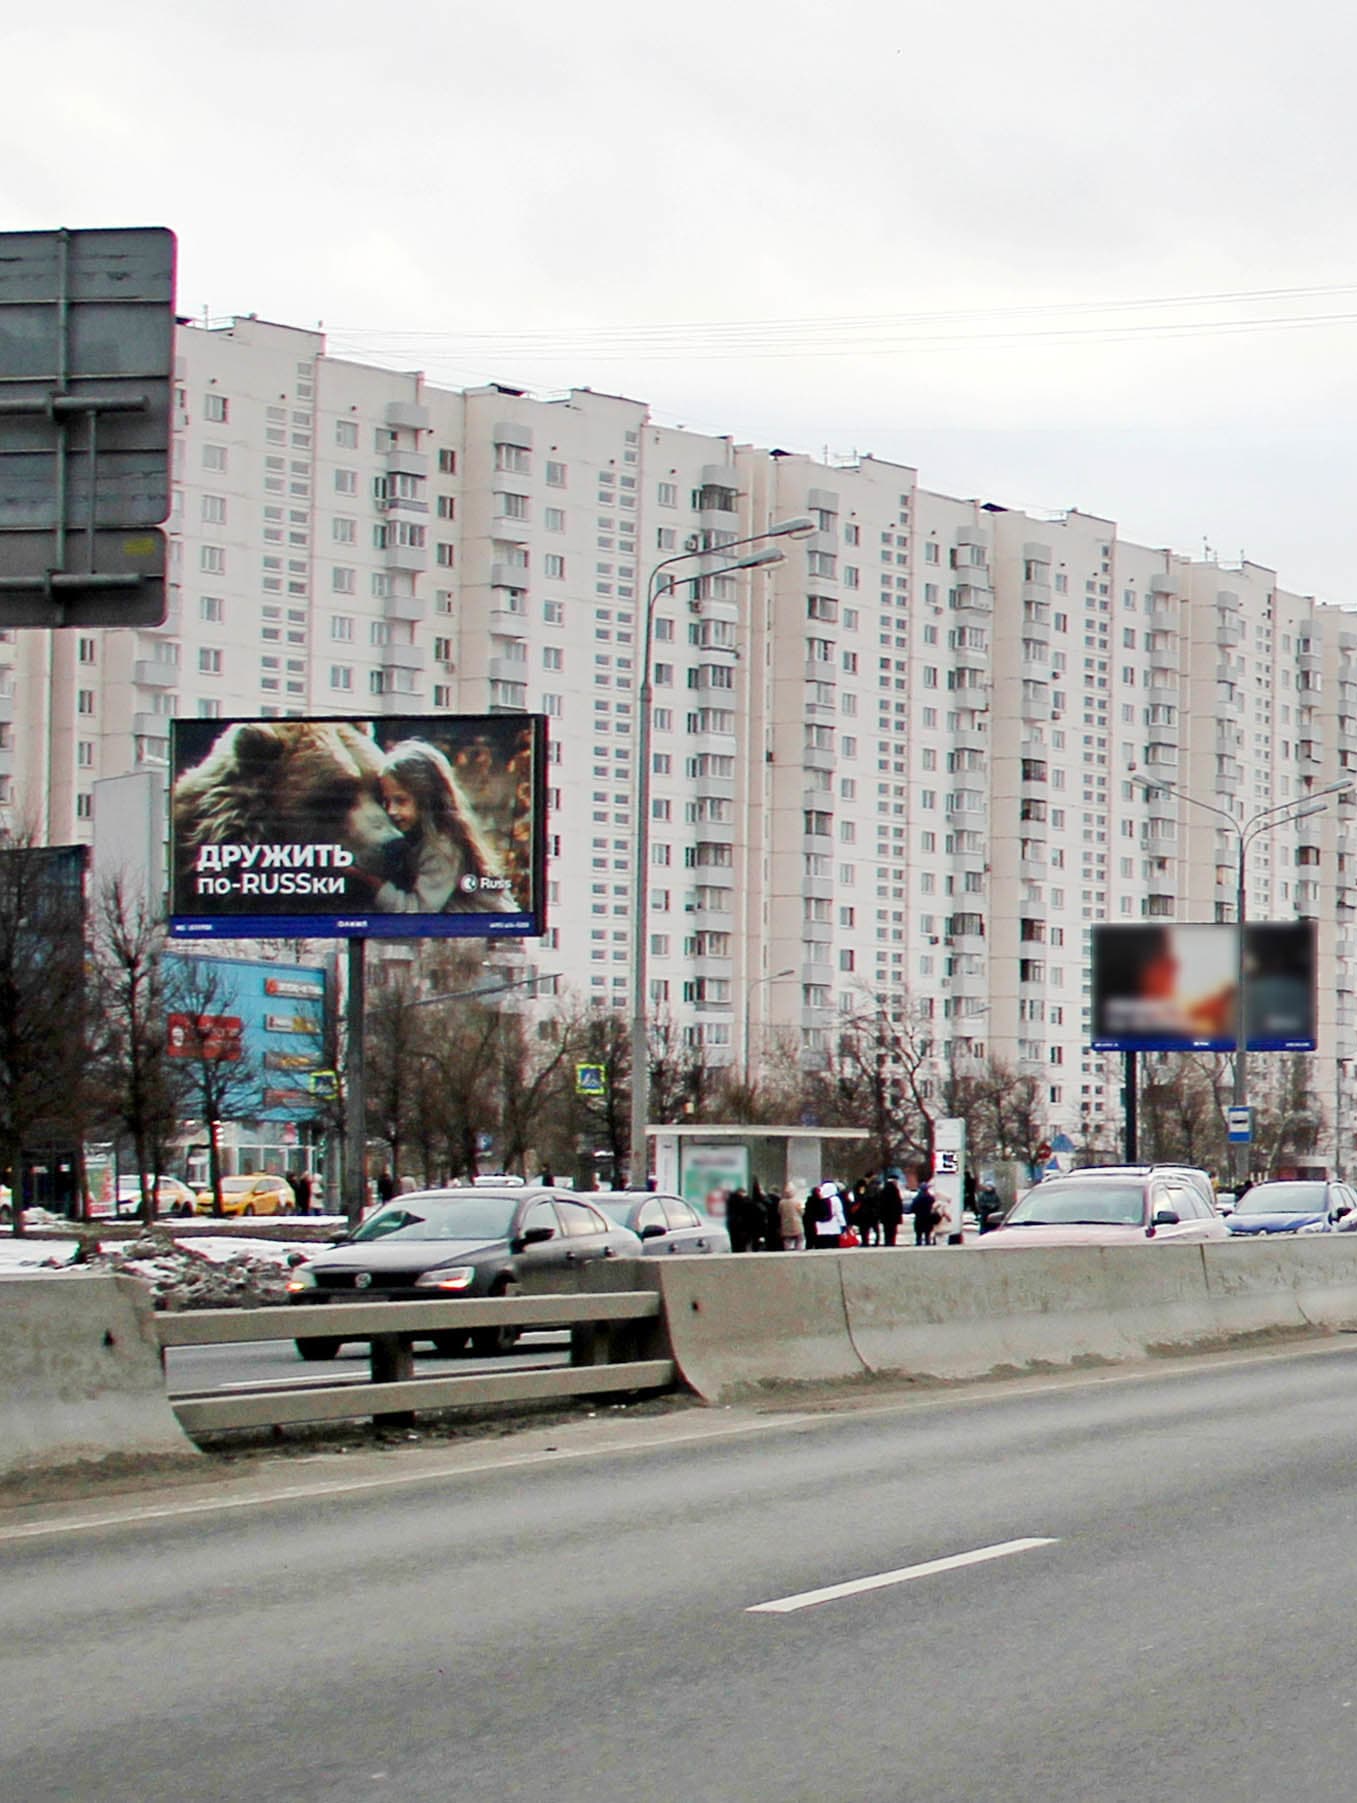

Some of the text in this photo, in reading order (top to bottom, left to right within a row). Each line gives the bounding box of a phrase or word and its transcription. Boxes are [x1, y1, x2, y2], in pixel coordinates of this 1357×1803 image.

[196, 844, 354, 872] ДРУЖИТЬ
[197, 872, 345, 894] по-RUSSки
[480, 877, 512, 889] Russ
